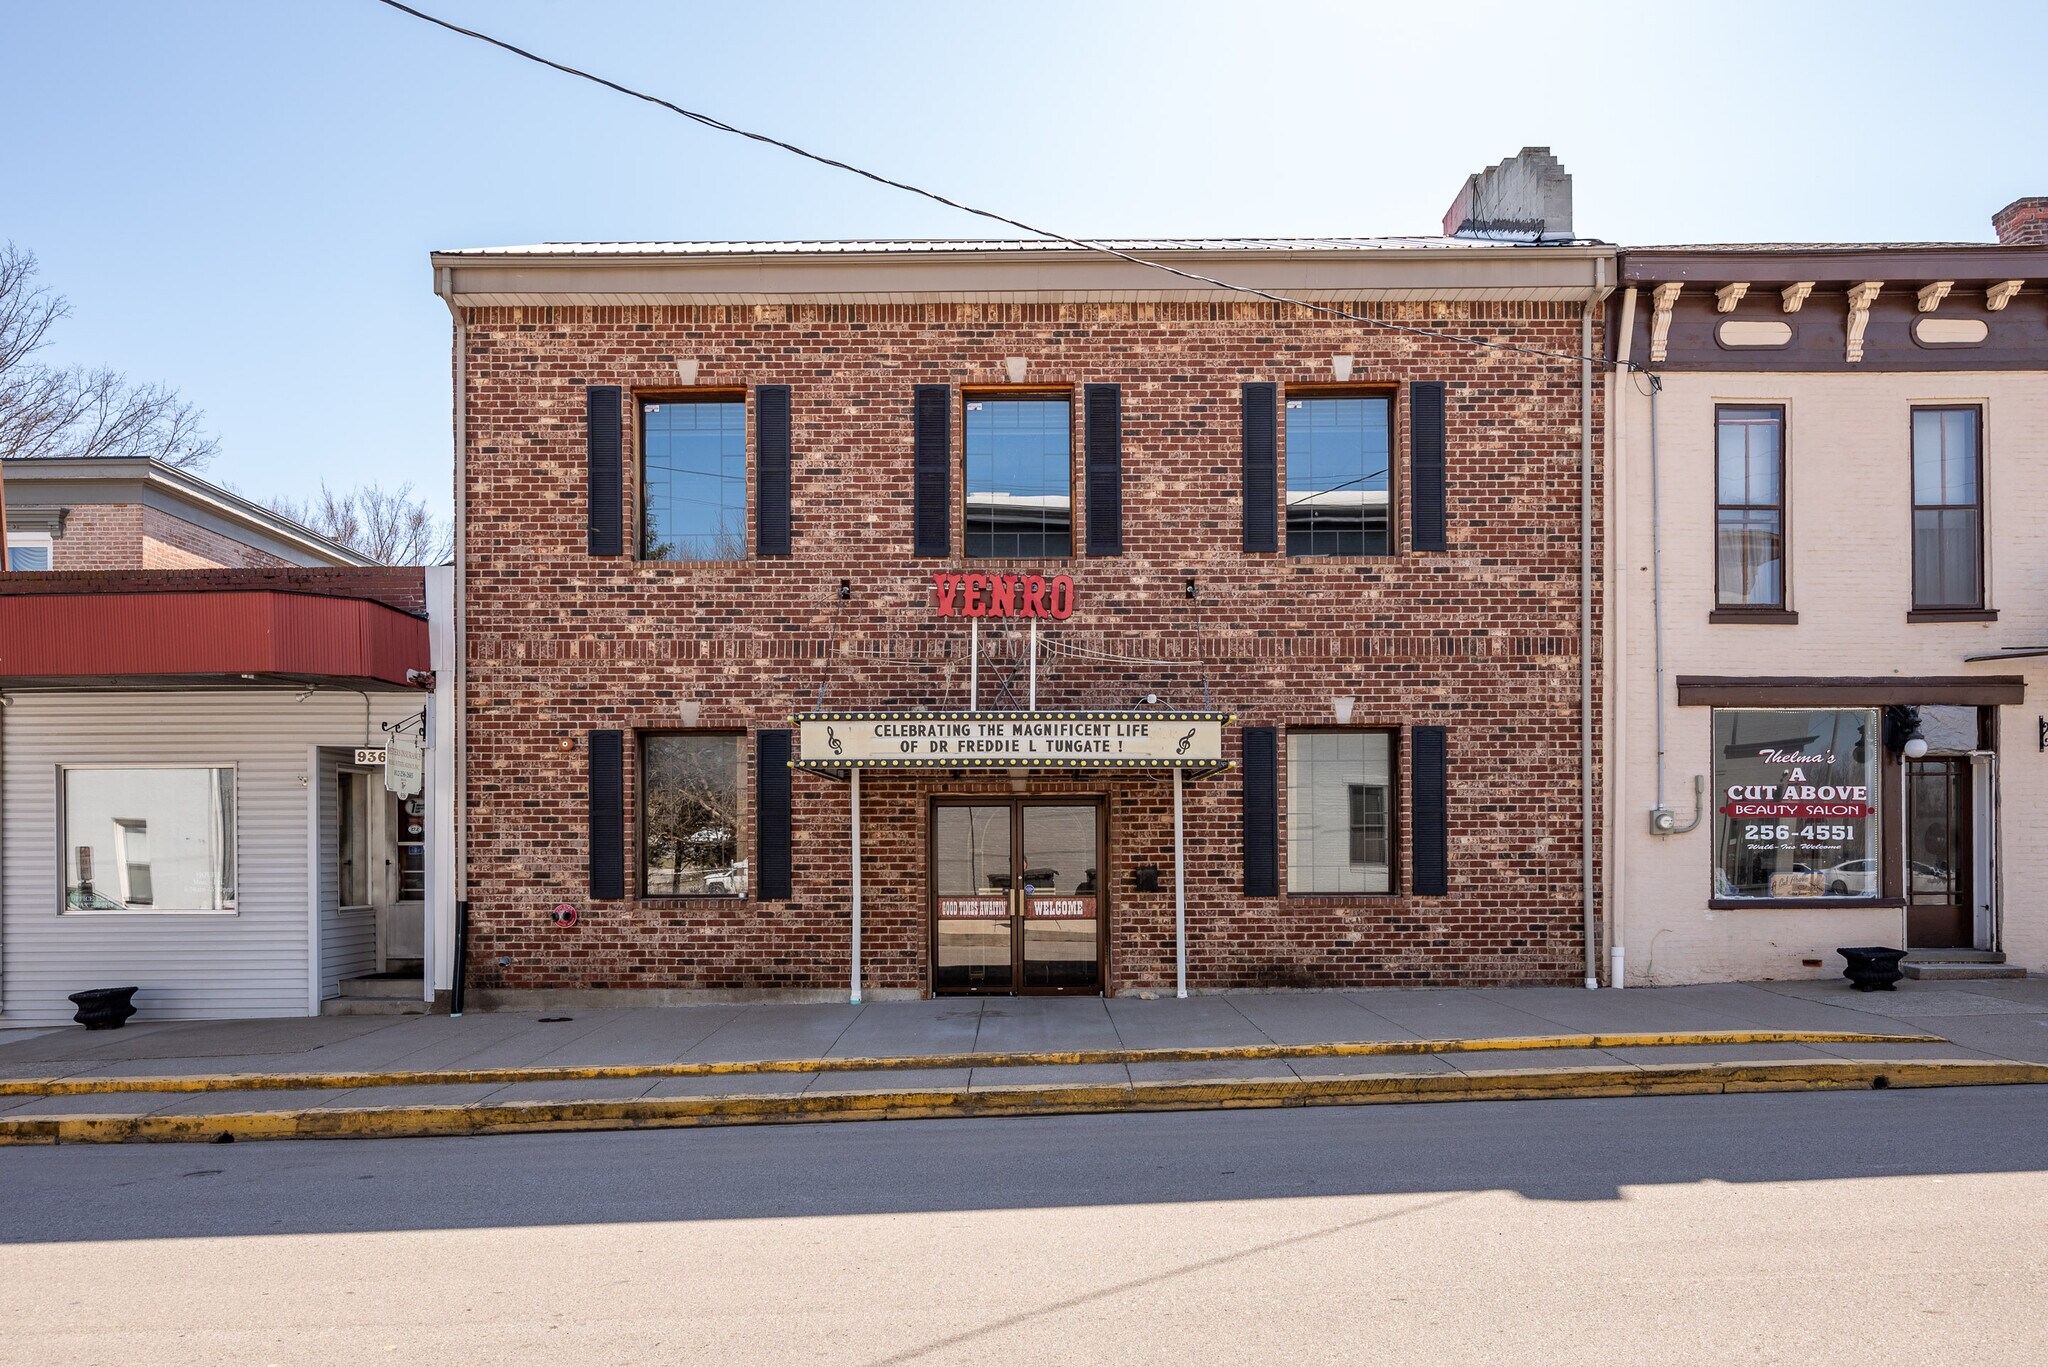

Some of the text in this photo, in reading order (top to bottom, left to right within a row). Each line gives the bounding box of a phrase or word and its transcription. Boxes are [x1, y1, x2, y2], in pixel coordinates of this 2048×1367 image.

[933, 573, 1075, 620] VENRO
[874, 723, 1149, 738] CELEBRATING THE MAGNIFICENT LIFE
[899, 739, 918, 754] OF
[929, 739, 949, 754] DR
[957, 739, 1021, 754] FREDDIE
[1028, 739, 1038, 753] L
[1045, 739, 1111, 754] TUNGATE
[357, 751, 386, 763] 936
[1759, 748, 1837, 764] Thelma's
[1788, 767, 1807, 782] A
[1727, 785, 1867, 801] CUT ABOVE
[1735, 804, 1859, 816] BEAUTY SALON
[1744, 824, 1855, 841] 256-4551
[1800, 842, 1842, 851] Welcome
[942, 900, 958, 916] GOOD
[958, 900, 979, 916] TIMES
[1033, 900, 1084, 916] WELCOME
